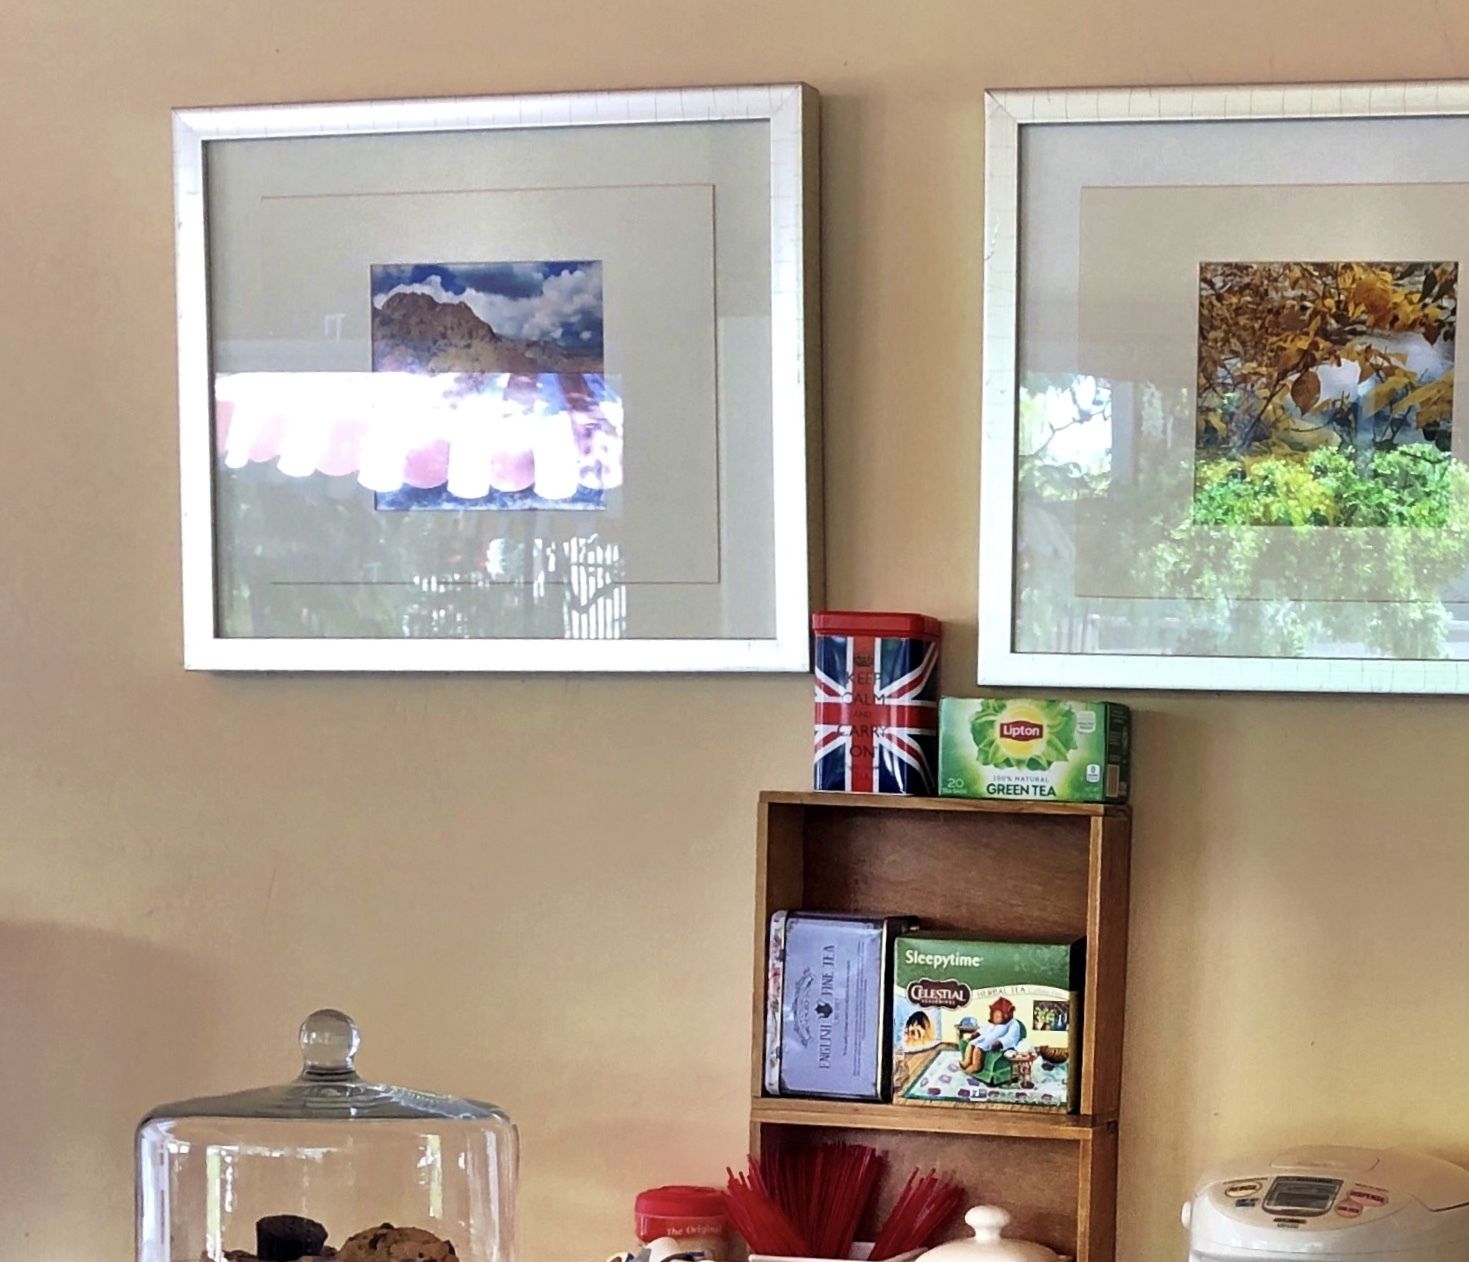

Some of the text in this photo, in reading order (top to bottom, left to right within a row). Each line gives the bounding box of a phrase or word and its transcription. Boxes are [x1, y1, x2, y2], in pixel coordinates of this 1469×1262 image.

[846, 672, 881, 684] KEEP
[842, 692, 886, 706] CALM
[837, 724, 886, 737] CARRY
[1003, 725, 1040, 738] Lipton
[850, 745, 878, 758] ON
[947, 777, 965, 788] 20
[986, 783, 1057, 797] GREEN TEA
[905, 950, 981, 968] Sleepytime
[911, 984, 966, 1001] CELESTIAL
[819, 945, 835, 1069] ENGLISH FINE TEA
[666, 1227, 683, 1236] The
